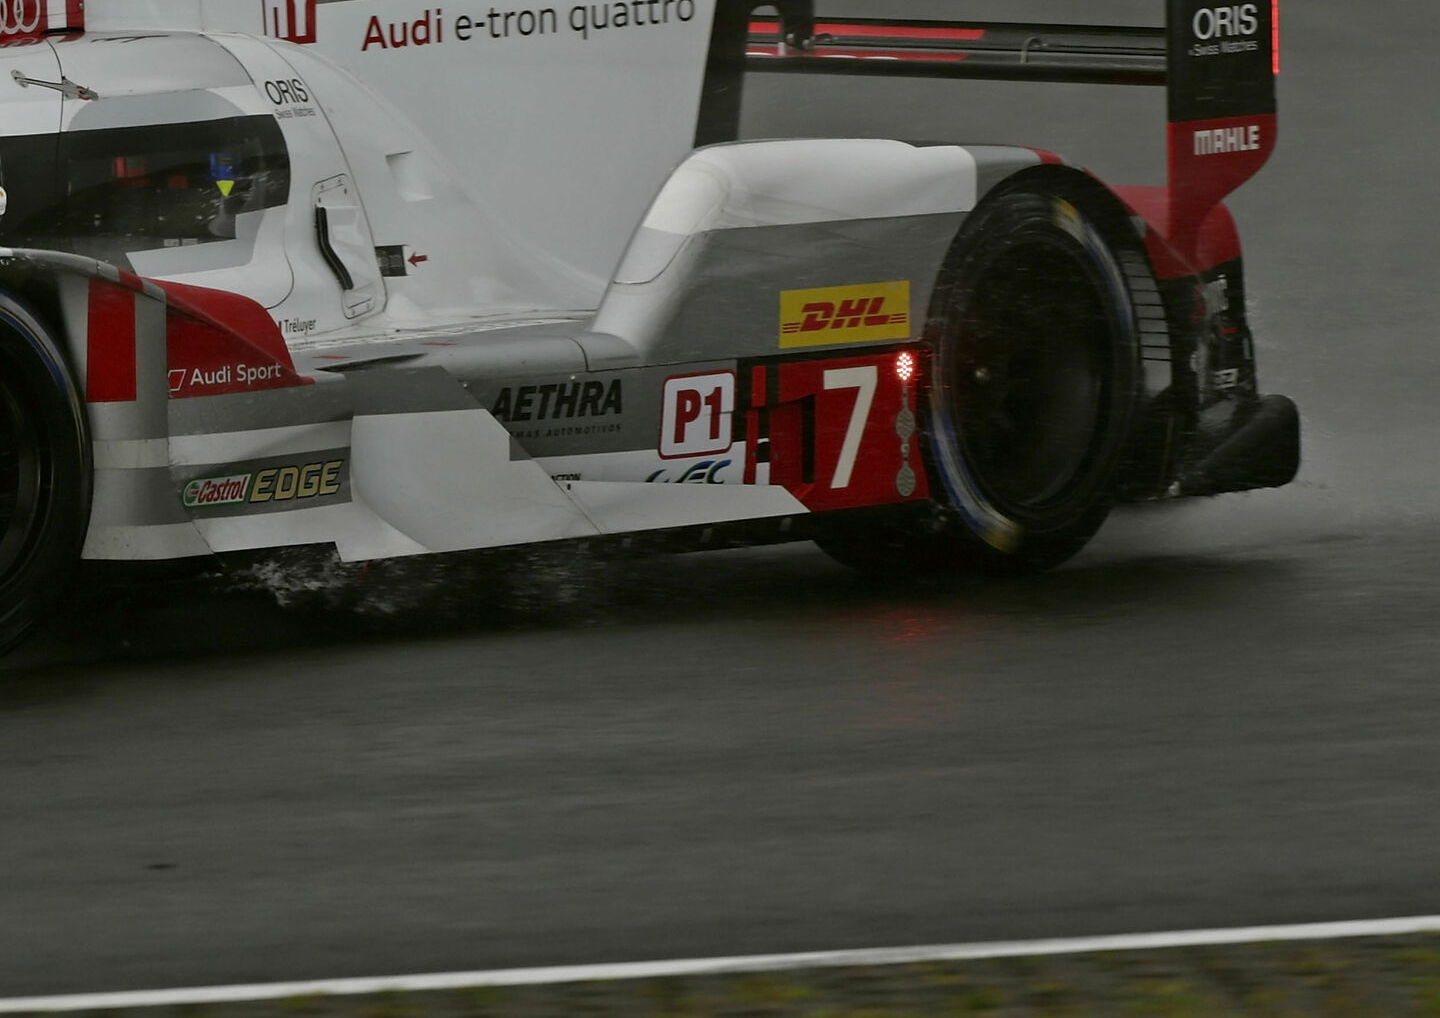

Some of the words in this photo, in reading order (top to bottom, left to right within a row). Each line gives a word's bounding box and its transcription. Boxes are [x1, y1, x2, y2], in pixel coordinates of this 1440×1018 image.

[362, 8, 443, 51] Audi
[454, 7, 558, 41] e-tron
[1192, 3, 1258, 40] ORIS
[264, 78, 309, 105] ORIS
[1194, 126, 1259, 155] MAHLE
[799, 297, 889, 332] DHL
[190, 365, 231, 386] Audi
[236, 362, 282, 385] Sport
[491, 379, 623, 422] AETHRA
[673, 386, 723, 444] P1
[822, 365, 878, 489] 7
[197, 476, 248, 504] Castrol
[249, 460, 343, 503] EDGE
